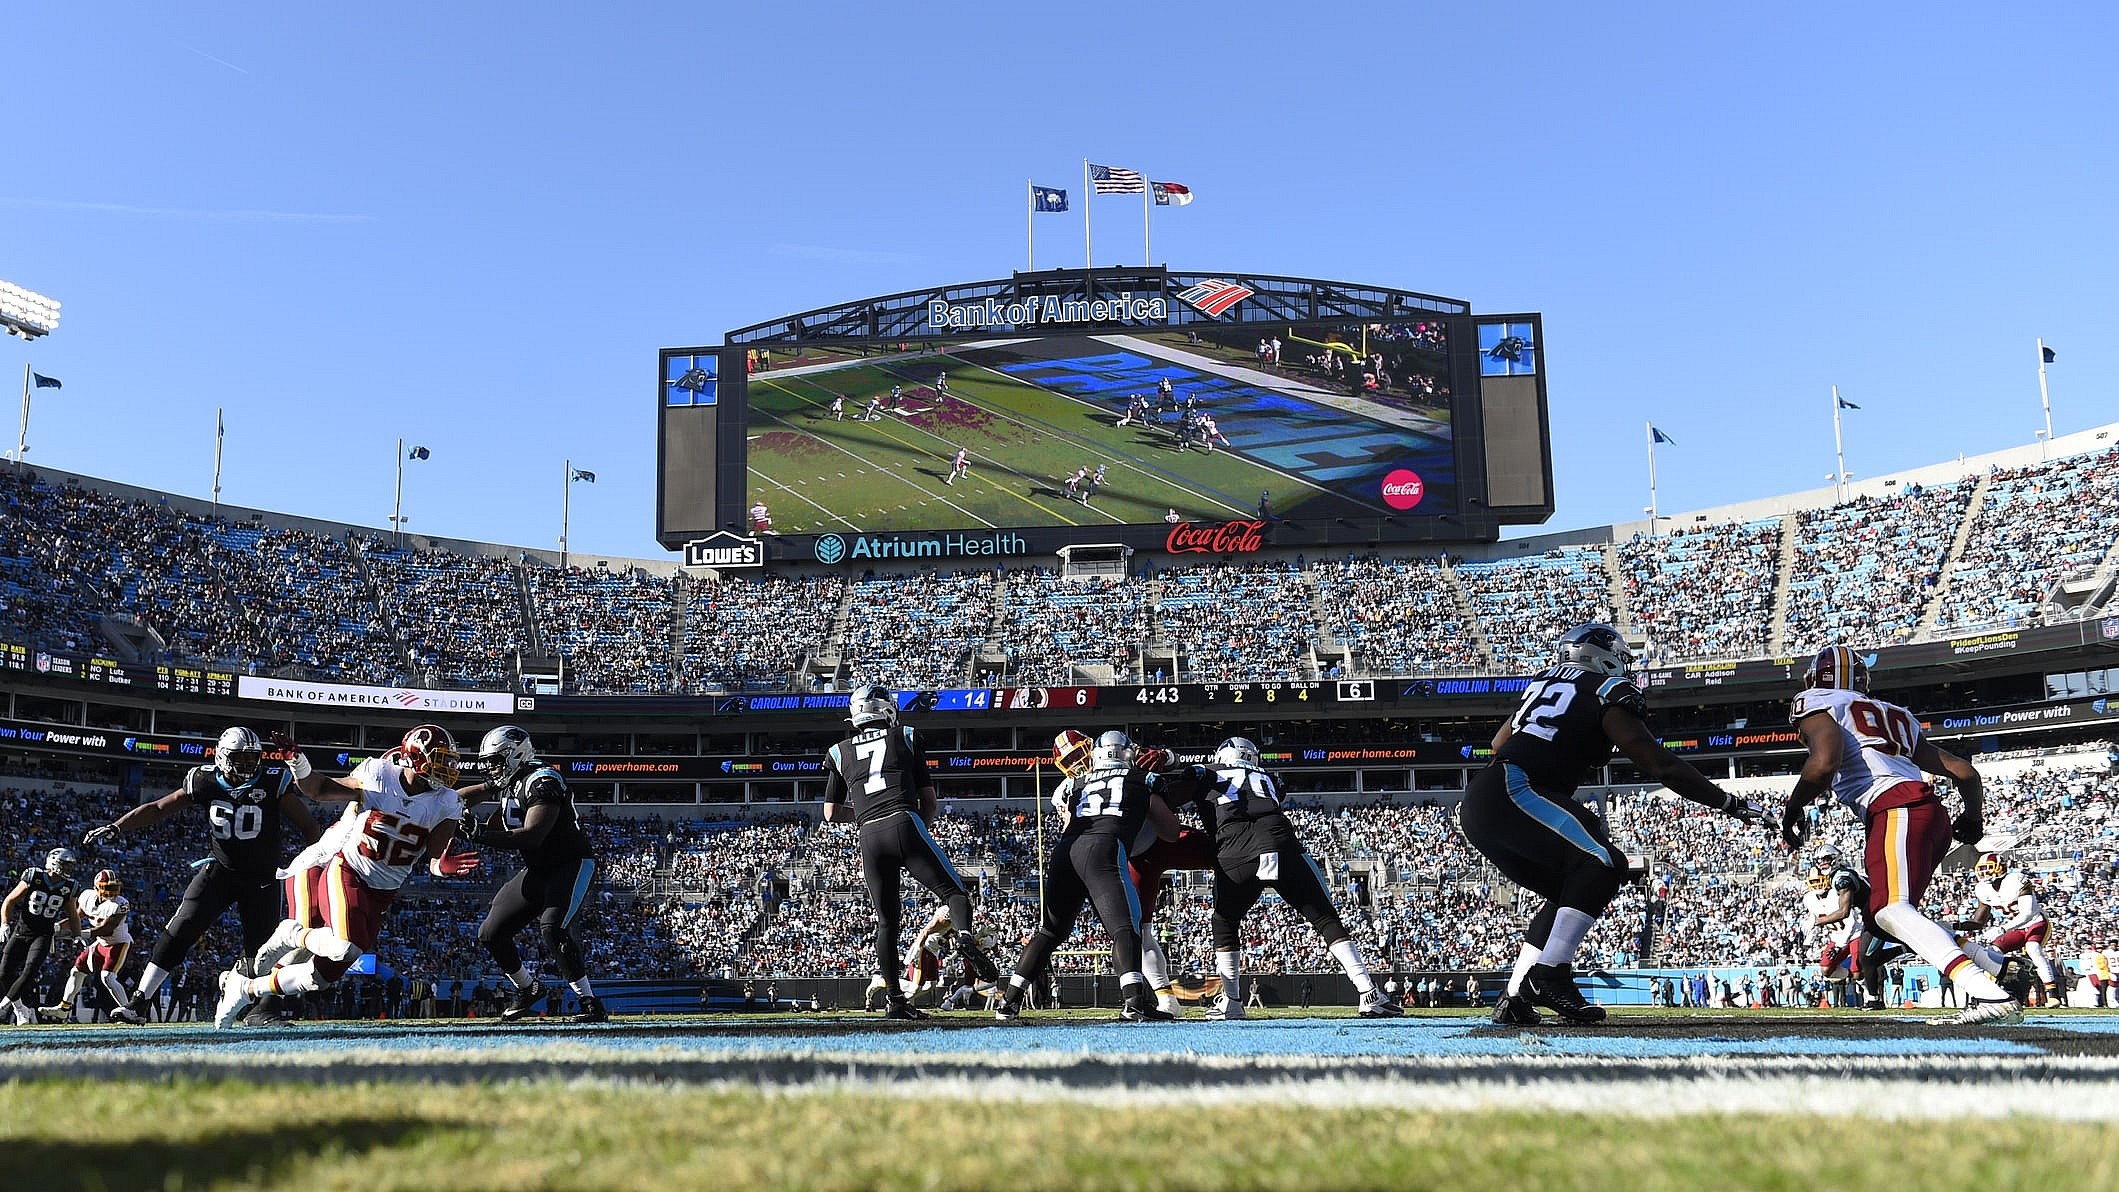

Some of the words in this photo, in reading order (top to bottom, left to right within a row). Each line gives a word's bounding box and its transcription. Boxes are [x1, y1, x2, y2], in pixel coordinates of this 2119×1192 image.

[929, 299, 1005, 328] Bank
[1006, 296, 1037, 325] of
[1041, 292, 1167, 323] America
[1166, 520, 1267, 554] Coca-Cola
[851, 535, 940, 559] Atrium
[946, 532, 1026, 556] Health
[692, 545, 755, 565] LOWE'S
[1950, 633, 2019, 648] PrideofLionsDen
[1954, 640, 2016, 654] #KeepPounding
[89, 673, 101, 681] KC
[109, 675, 131, 685] Butker
[157, 681, 169, 689] 104
[90, 665, 102, 673] NO
[109, 667, 125, 676] Lutz
[158, 674, 169, 682] 110
[1685, 672, 1701, 680] CAR
[1704, 670, 1736, 678] Addison
[1204, 684, 1219, 692] QTR
[1229, 683, 1250, 691] DOWN
[1437, 680, 1490, 694] CAROLINA
[1493, 678, 1530, 693] PANTH
[1705, 678, 1722, 686] Reid
[268, 687, 304, 700] BANK
[307, 690, 324, 701] OF
[328, 692, 390, 706] AMERICA
[1076, 689, 1087, 706] 6
[1136, 687, 1180, 704] 4:43
[1208, 692, 1214, 700] 2
[1234, 691, 1243, 703] 2
[1266, 690, 1275, 702] 8
[1298, 689, 1308, 701] 4
[1350, 683, 1361, 698] 6
[424, 698, 486, 710] STADIUM
[520, 699, 532, 709] CC
[750, 696, 800, 710] CAROLINA
[803, 695, 850, 708] PANTHER
[964, 692, 986, 708] 14
[1512, 679, 1577, 742] 72
[1943, 718, 1971, 730] Own
[1974, 715, 2001, 726] Your
[2003, 710, 2042, 723] Power
[2043, 705, 2072, 719] with
[851, 728, 889, 745] ALLEN
[1849, 700, 1916, 757] 90
[20, 727, 45, 741] Your
[46, 730, 81, 745] Power
[82, 735, 107, 748] with
[1708, 734, 1733, 746] Visit
[179, 742, 204, 755] Visit
[1303, 749, 1326, 760] Visit
[772, 761, 795, 771] Own
[797, 761, 820, 771] Your
[949, 757, 972, 767] Visit
[1179, 753, 1206, 763] ower
[572, 761, 594, 772] Visit
[595, 762, 679, 775] powerhome.com
[855, 738, 887, 796] 7
[1076, 776, 1125, 818] 61
[209, 799, 263, 841] 60
[358, 807, 430, 867] 52
[28, 890, 64, 919] 88
